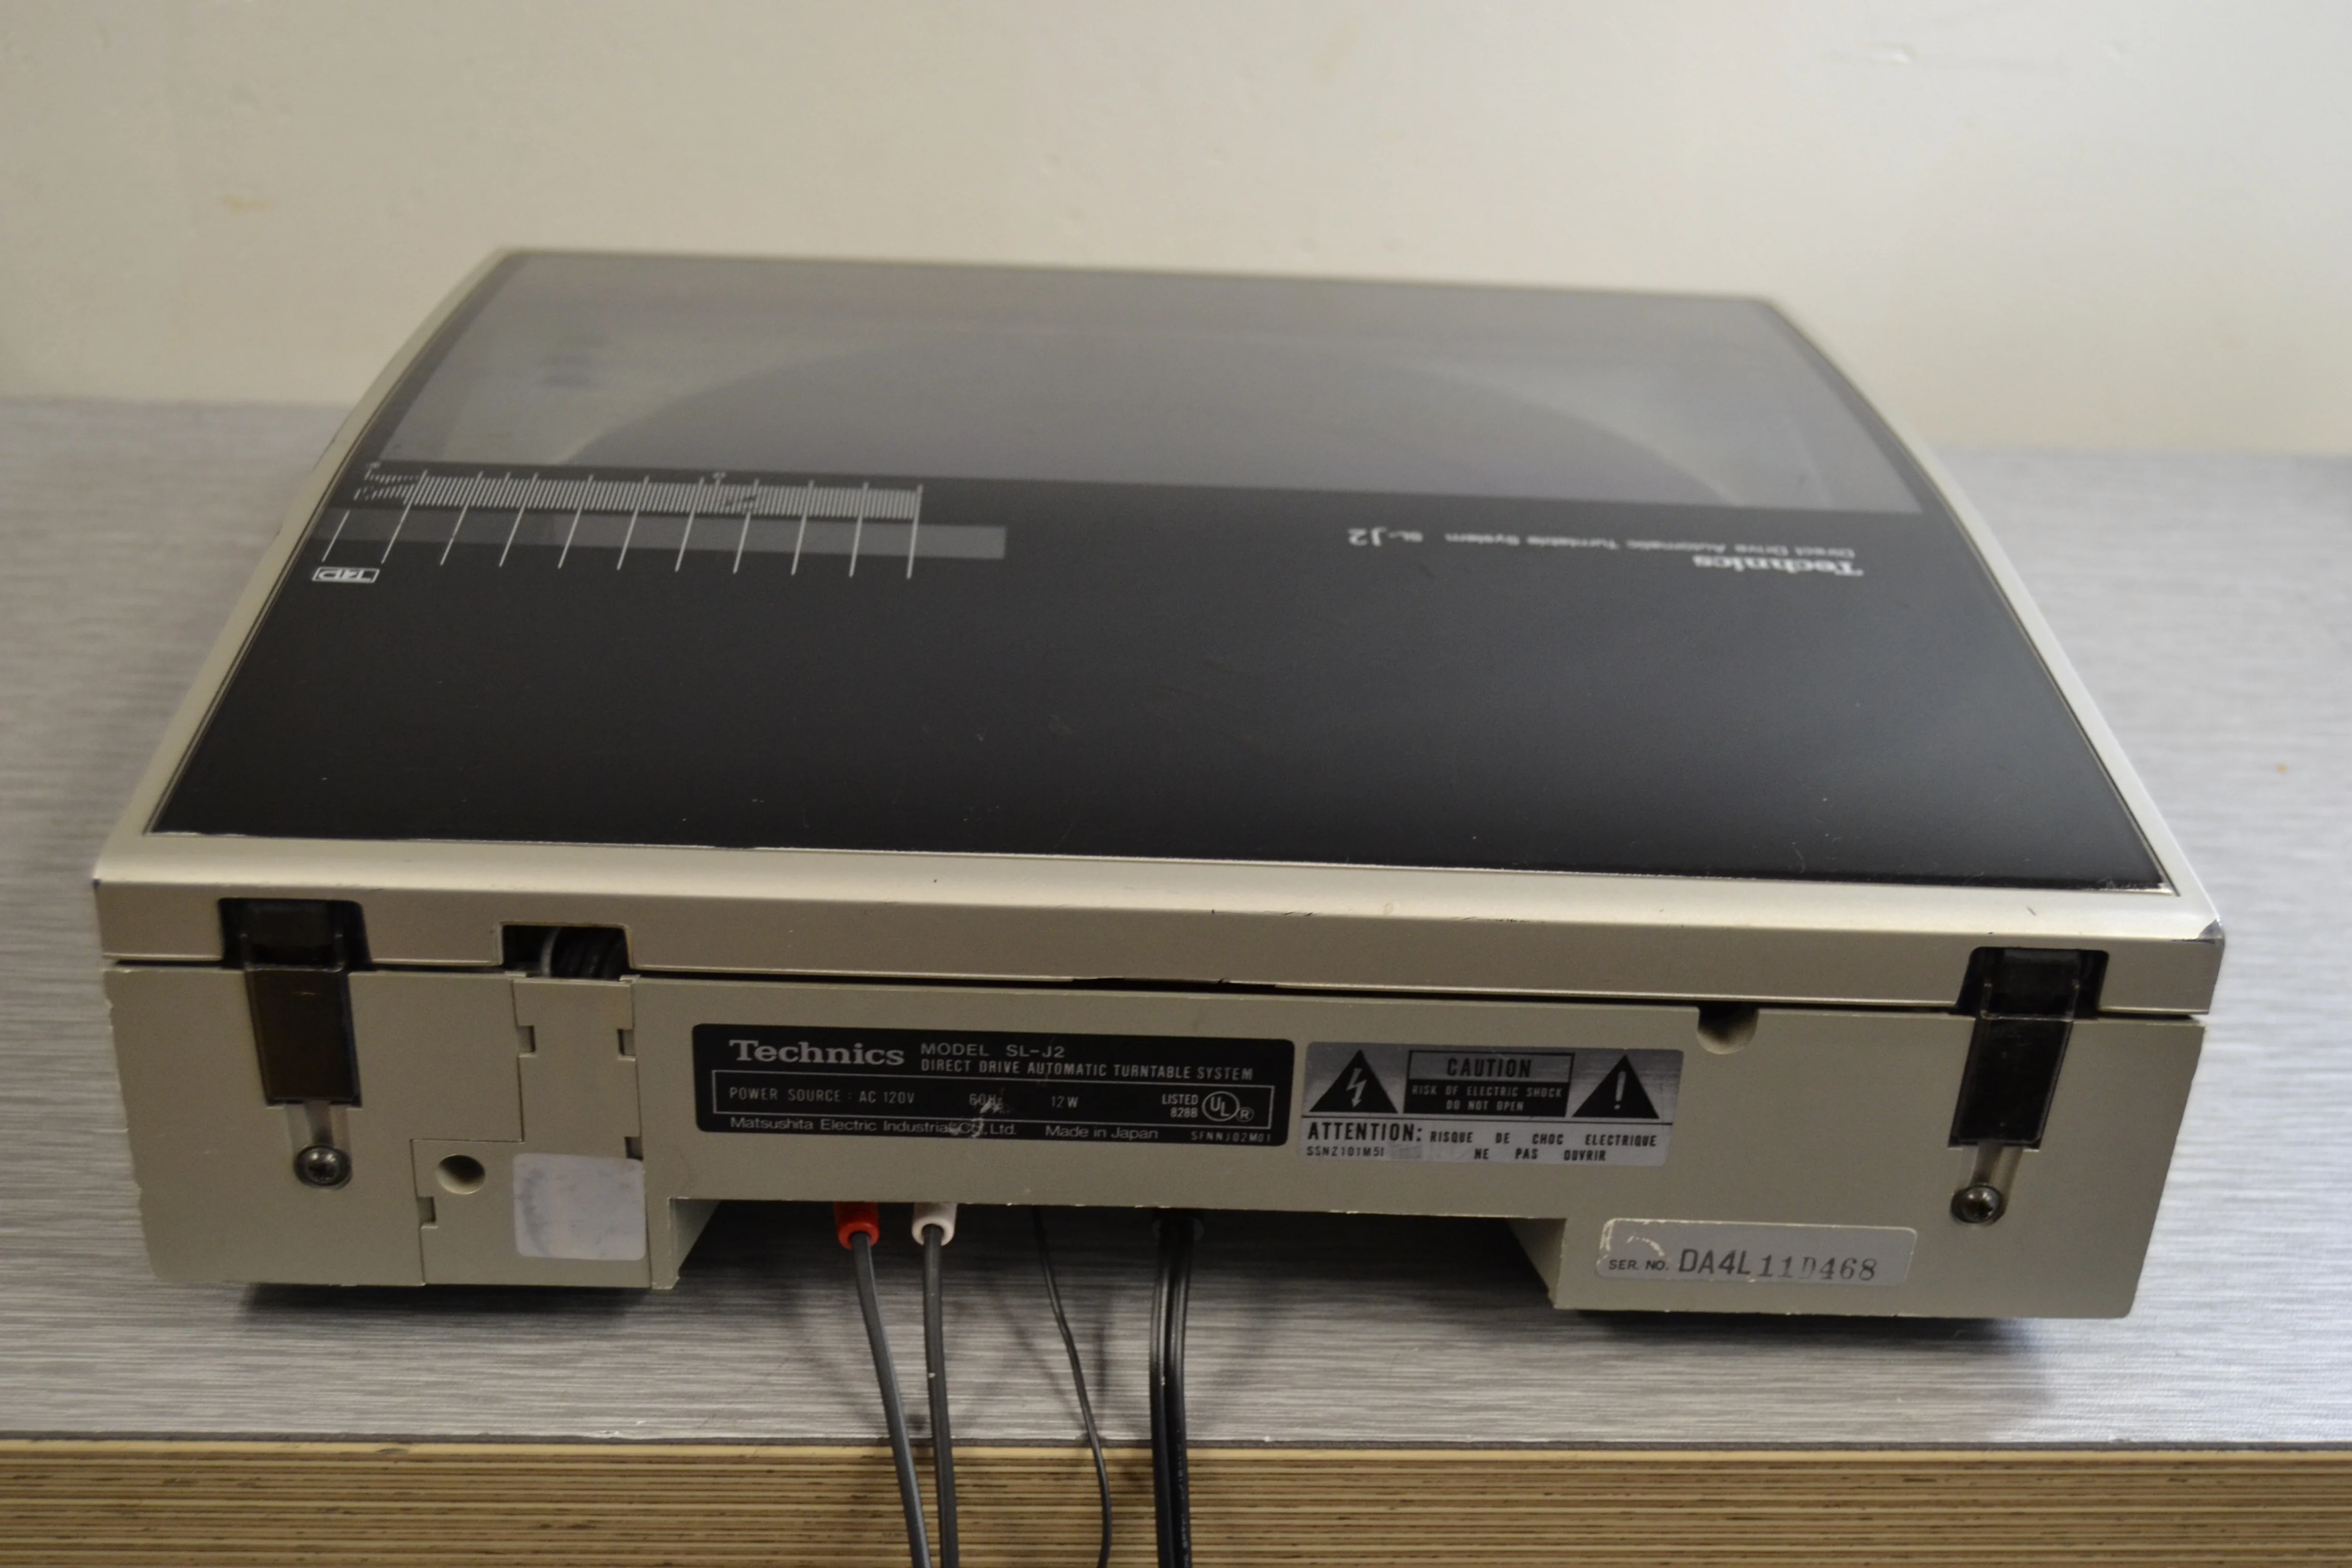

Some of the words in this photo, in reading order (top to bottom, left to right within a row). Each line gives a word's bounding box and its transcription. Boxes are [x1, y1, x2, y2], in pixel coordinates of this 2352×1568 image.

[1693, 555, 1864, 576] Technics
[729, 1039, 905, 1066] Technics
[920, 1043, 990, 1057] MODEL
[1006, 1044, 1065, 1058] SL-J2
[920, 1060, 971, 1072] DIRECT
[979, 1060, 1020, 1073] DRIVE
[1027, 1062, 1107, 1076] AUTOMATIC
[1114, 1064, 1191, 1079] TURNTABLE
[1197, 1067, 1253, 1081] SYSTEM
[1447, 1058, 1533, 1079] CAUTION
[729, 1087, 778, 1100] POWER
[788, 1089, 841, 1102] SOURCE
[859, 1091, 876, 1104] AC
[884, 1091, 915, 1104] 120V
[1162, 1094, 1198, 1105] LISTED
[1412, 1085, 1437, 1095] RISK
[1446, 1086, 1459, 1096] OF
[1466, 1086, 1518, 1097] ELECTRIC
[1526, 1087, 1563, 1098] SHOCK
[1446, 1100, 1460, 1110] DO
[1467, 1100, 1489, 1111] NOT
[1496, 1101, 1525, 1112] OPEN
[730, 1117, 814, 1130] Matsushita
[820, 1118, 876, 1132] Electric
[1308, 1121, 1423, 1142] ATTENTION:
[1046, 1125, 1088, 1138] Made
[1094, 1126, 1107, 1138] in
[1111, 1126, 1158, 1141] Japan
[1430, 1131, 1474, 1143] RISQUE
[1495, 1132, 1510, 1145] DE
[1532, 1133, 1564, 1145] CHOC
[1585, 1134, 1657, 1147] ELECTRIQUE
[1474, 1148, 1489, 1160] NE
[1515, 1148, 1538, 1160] PAS
[1563, 1150, 1606, 1161] OUVRIR
[1646, 1261, 1669, 1271] NO.
